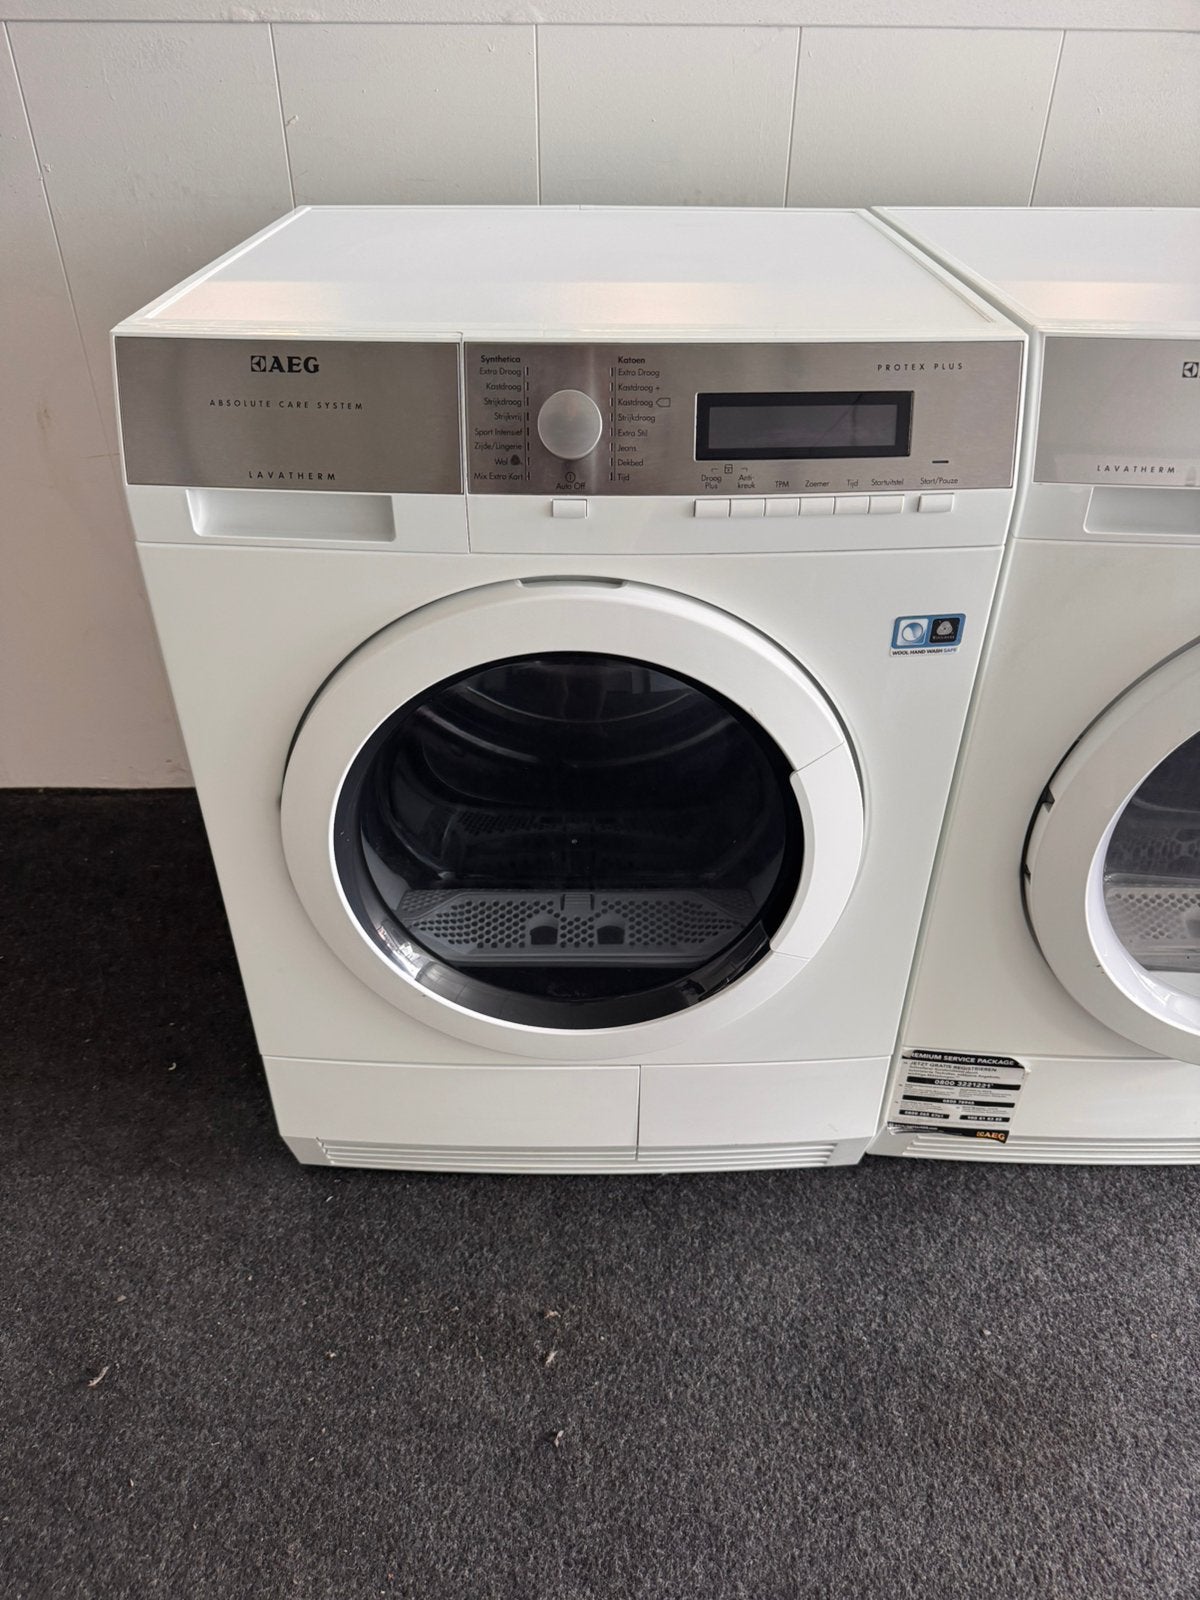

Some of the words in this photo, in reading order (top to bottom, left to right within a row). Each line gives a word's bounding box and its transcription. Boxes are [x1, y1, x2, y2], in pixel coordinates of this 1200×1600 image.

[617, 355, 646, 364] Katoen
[268, 356, 320, 373] AEG
[877, 363, 925, 372] PROTEX
[934, 362, 964, 371] PLUS
[479, 367, 498, 375] Extra
[499, 367, 522, 377] Droog
[618, 368, 636, 376] Extra
[638, 368, 660, 378] Droog
[486, 382, 522, 392] Kastdroog
[617, 383, 654, 393] Kastdroog
[209, 399, 271, 408] ABSOLUTE
[279, 400, 309, 409] CARE
[317, 401, 363, 410] SYSTEM
[484, 397, 522, 407] Strijkdroog
[617, 398, 654, 408] Kastdroog
[617, 413, 656, 424] Strijkdroog
[474, 428, 493, 437] Sport
[617, 429, 636, 437] Extra
[617, 444, 637, 452] Jeans
[494, 457, 508, 465] Wol
[617, 458, 644, 466] Dekbed
[1097, 464, 1176, 473] LAVATHERM
[249, 471, 336, 480] LAVATHERM
[473, 472, 488, 480] Mix
[489, 472, 507, 480] Extra
[617, 473, 630, 482] Tijd
[701, 474, 722, 483] Droog
[805, 479, 829, 487] Zoemer
[847, 479, 859, 488] Tijd
[920, 476, 959, 485] Start/Pauze
[555, 482, 572, 490] Auto
[573, 482, 586, 490] Off
[943, 1054, 976, 1063] SERVICE
[977, 1058, 1015, 1066] PACKAGE
[984, 1131, 1006, 1141] AEG
